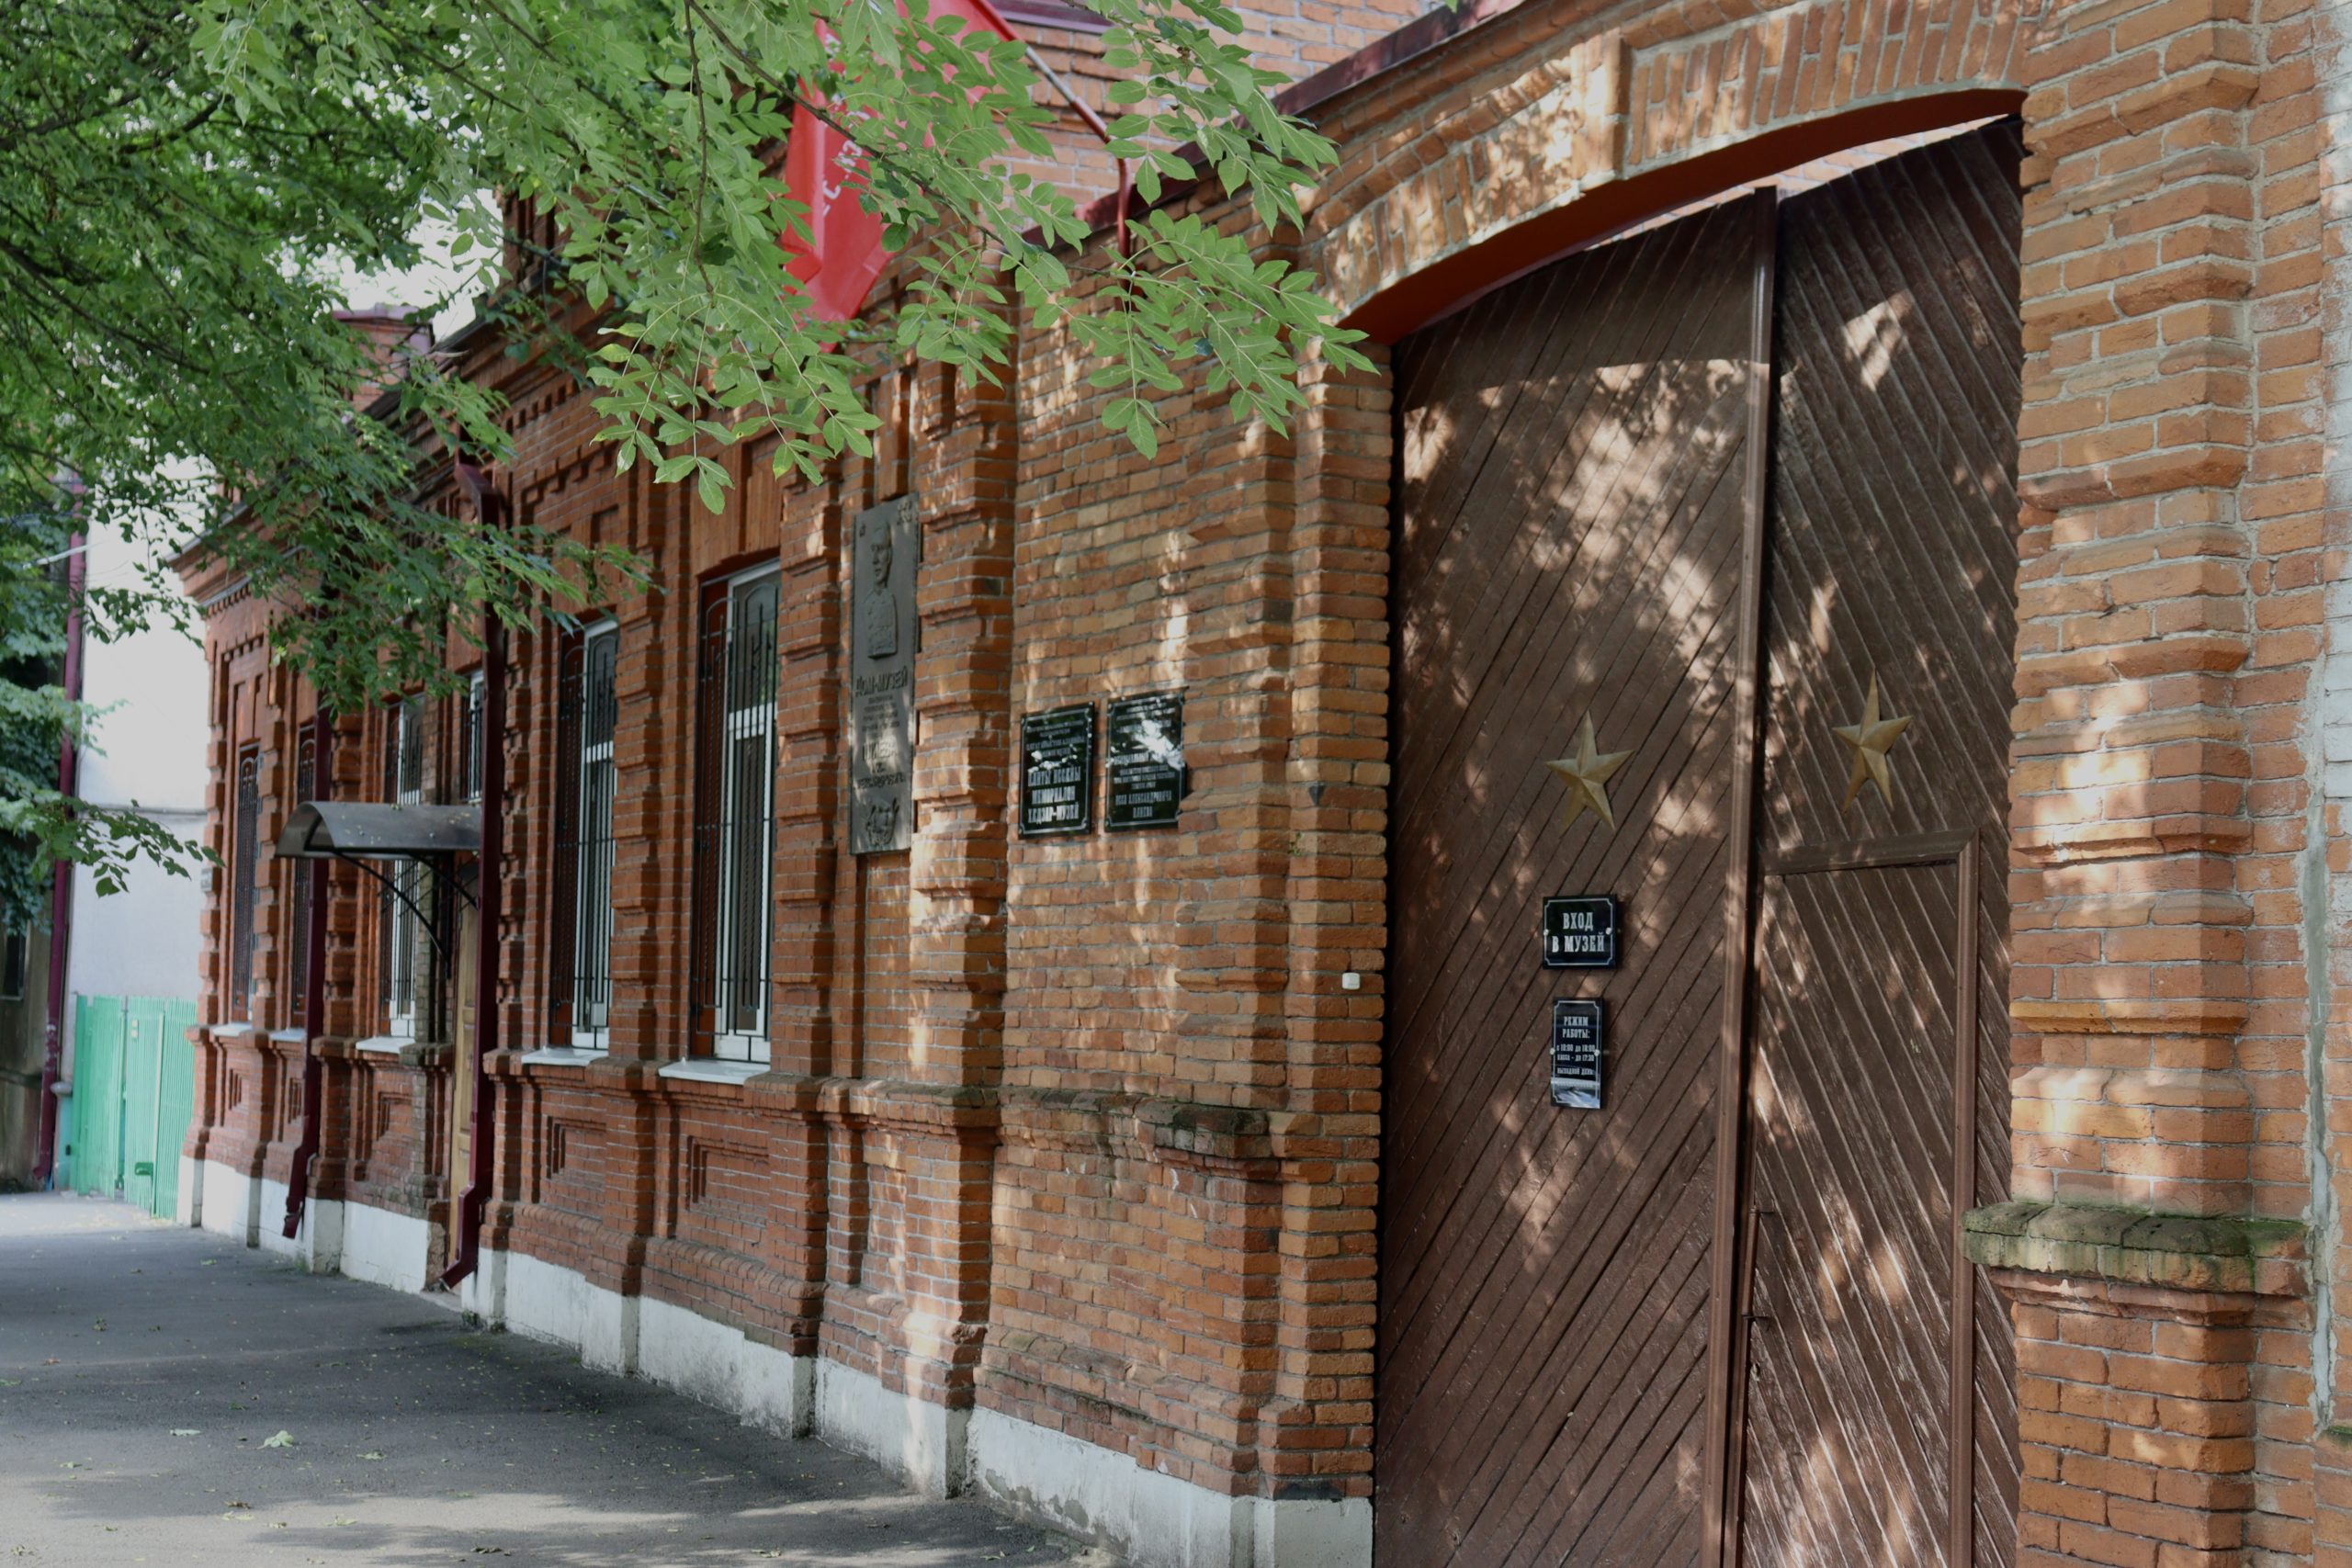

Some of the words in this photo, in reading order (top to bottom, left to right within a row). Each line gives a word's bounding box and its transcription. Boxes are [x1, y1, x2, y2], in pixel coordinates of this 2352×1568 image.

[1562, 911, 1594, 931] ВХОД
[1552, 935, 1559, 953] В
[1564, 931, 1605, 953] МУЗЕЙ
[1564, 1016, 1589, 1026] РЕЖИМ
[1562, 1029, 1590, 1038] РАБОТЫ:
